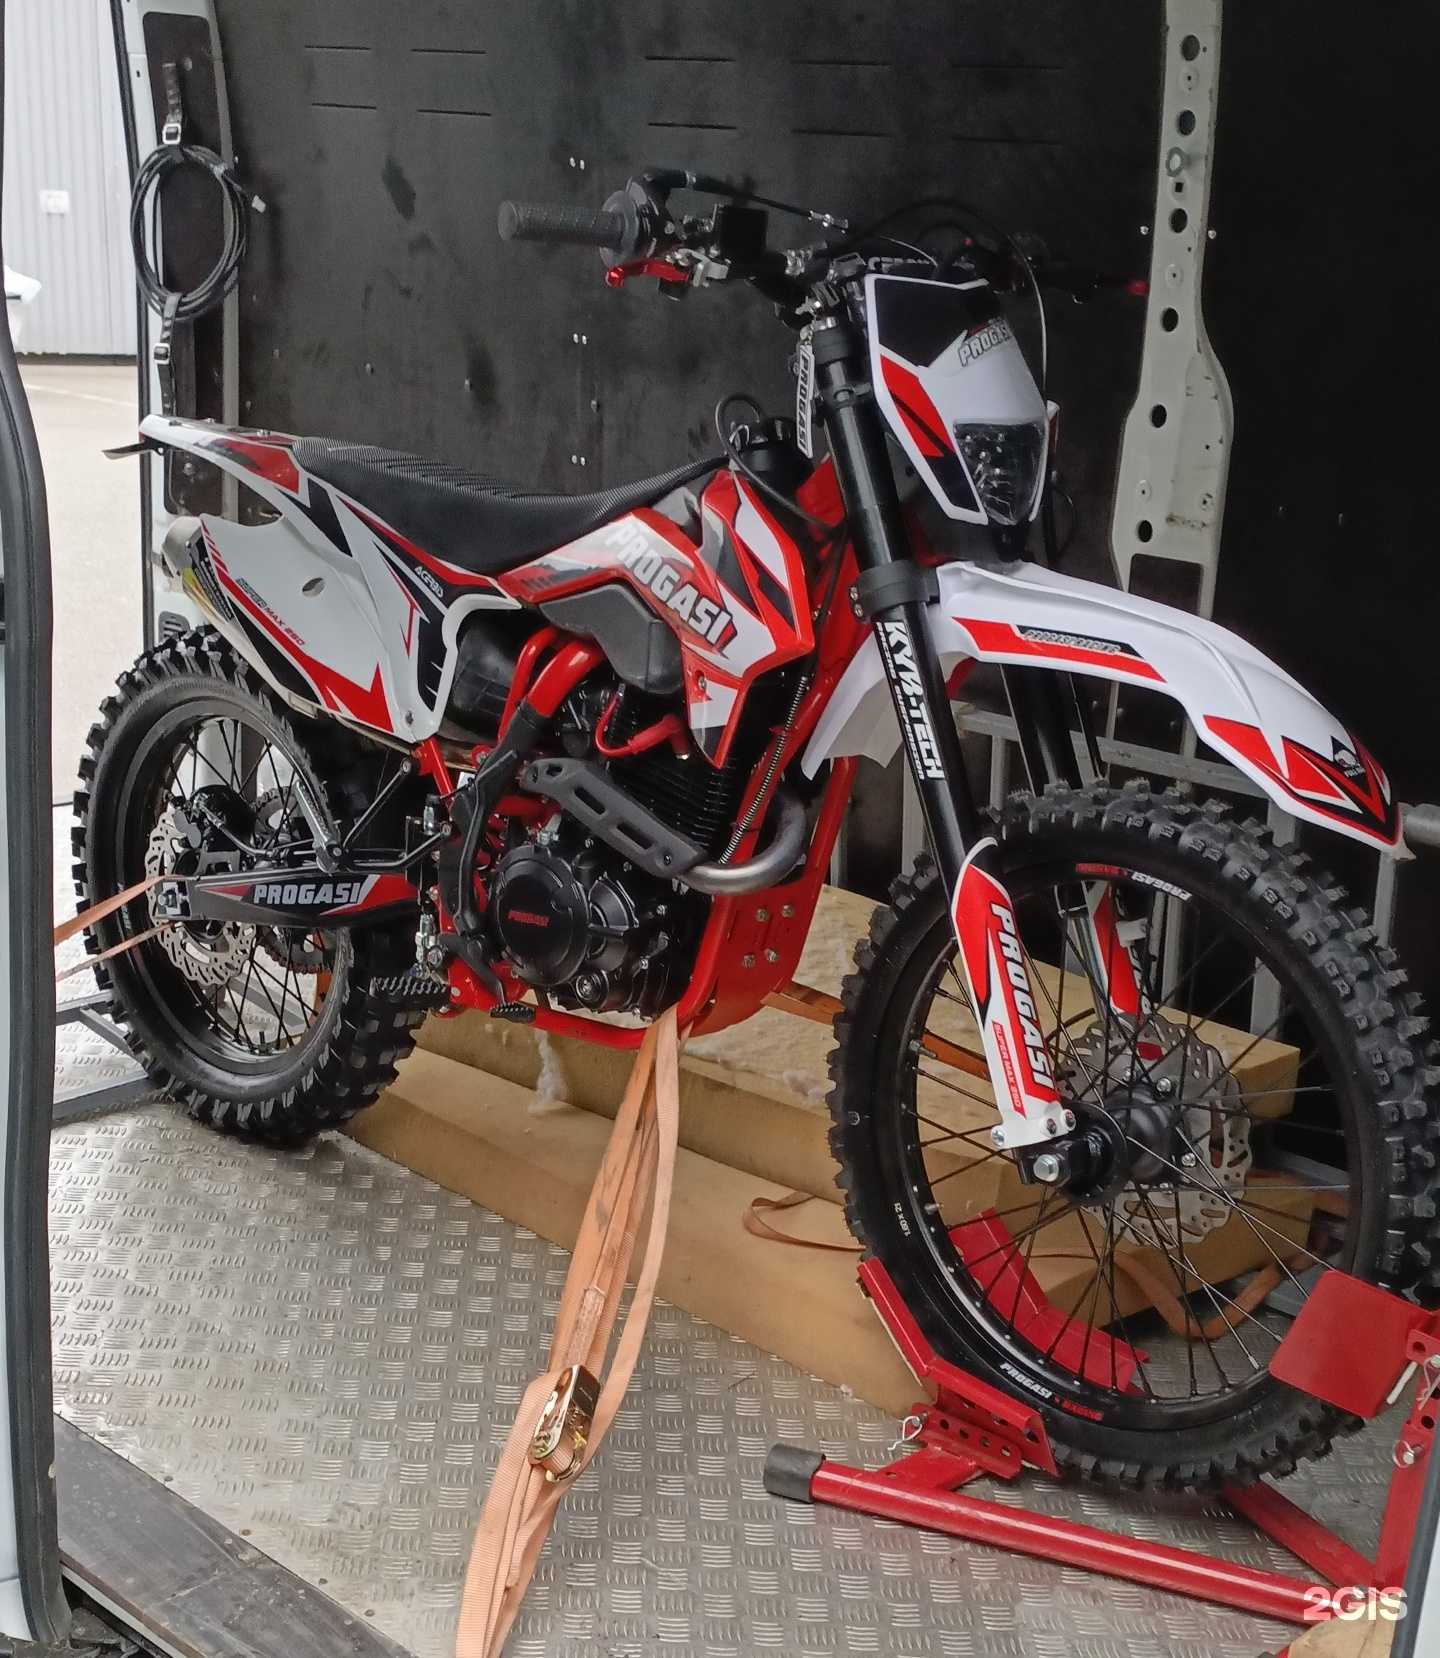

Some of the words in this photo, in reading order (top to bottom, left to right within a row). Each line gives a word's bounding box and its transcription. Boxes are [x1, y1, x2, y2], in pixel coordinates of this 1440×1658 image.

[604, 520, 734, 646] PROGASI
[883, 621, 945, 779] KYB-TECH
[253, 882, 361, 905] PROGASI
[1131, 870, 1193, 901] PROGASI
[989, 902, 1055, 1090] PROGASI
[1000, 1361, 1053, 1399] PROGASI
